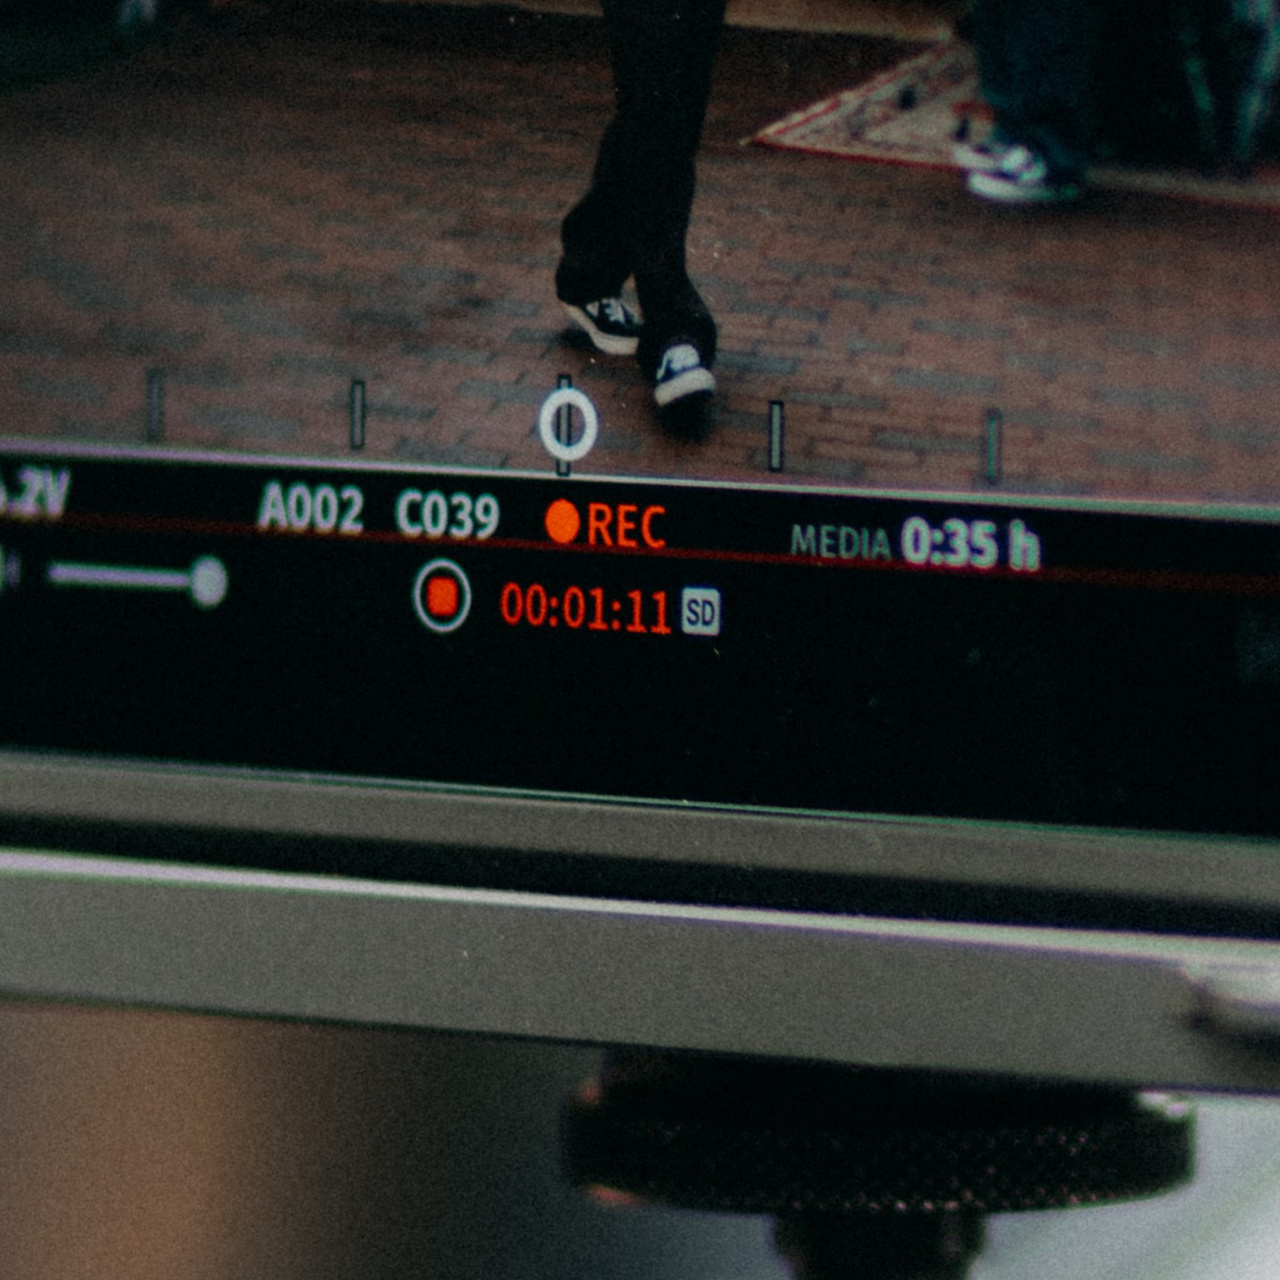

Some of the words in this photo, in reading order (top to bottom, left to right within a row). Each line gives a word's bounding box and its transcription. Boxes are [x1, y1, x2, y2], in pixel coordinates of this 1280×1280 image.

[257, 483, 364, 534] A002
[396, 490, 500, 539] C039
[588, 503, 666, 549] REC
[791, 524, 891, 561] MEDIA
[902, 516, 999, 570] 0:35
[1009, 520, 1041, 572] h
[500, 582, 672, 635] 00:01:11
[686, 596, 716, 628] SD
